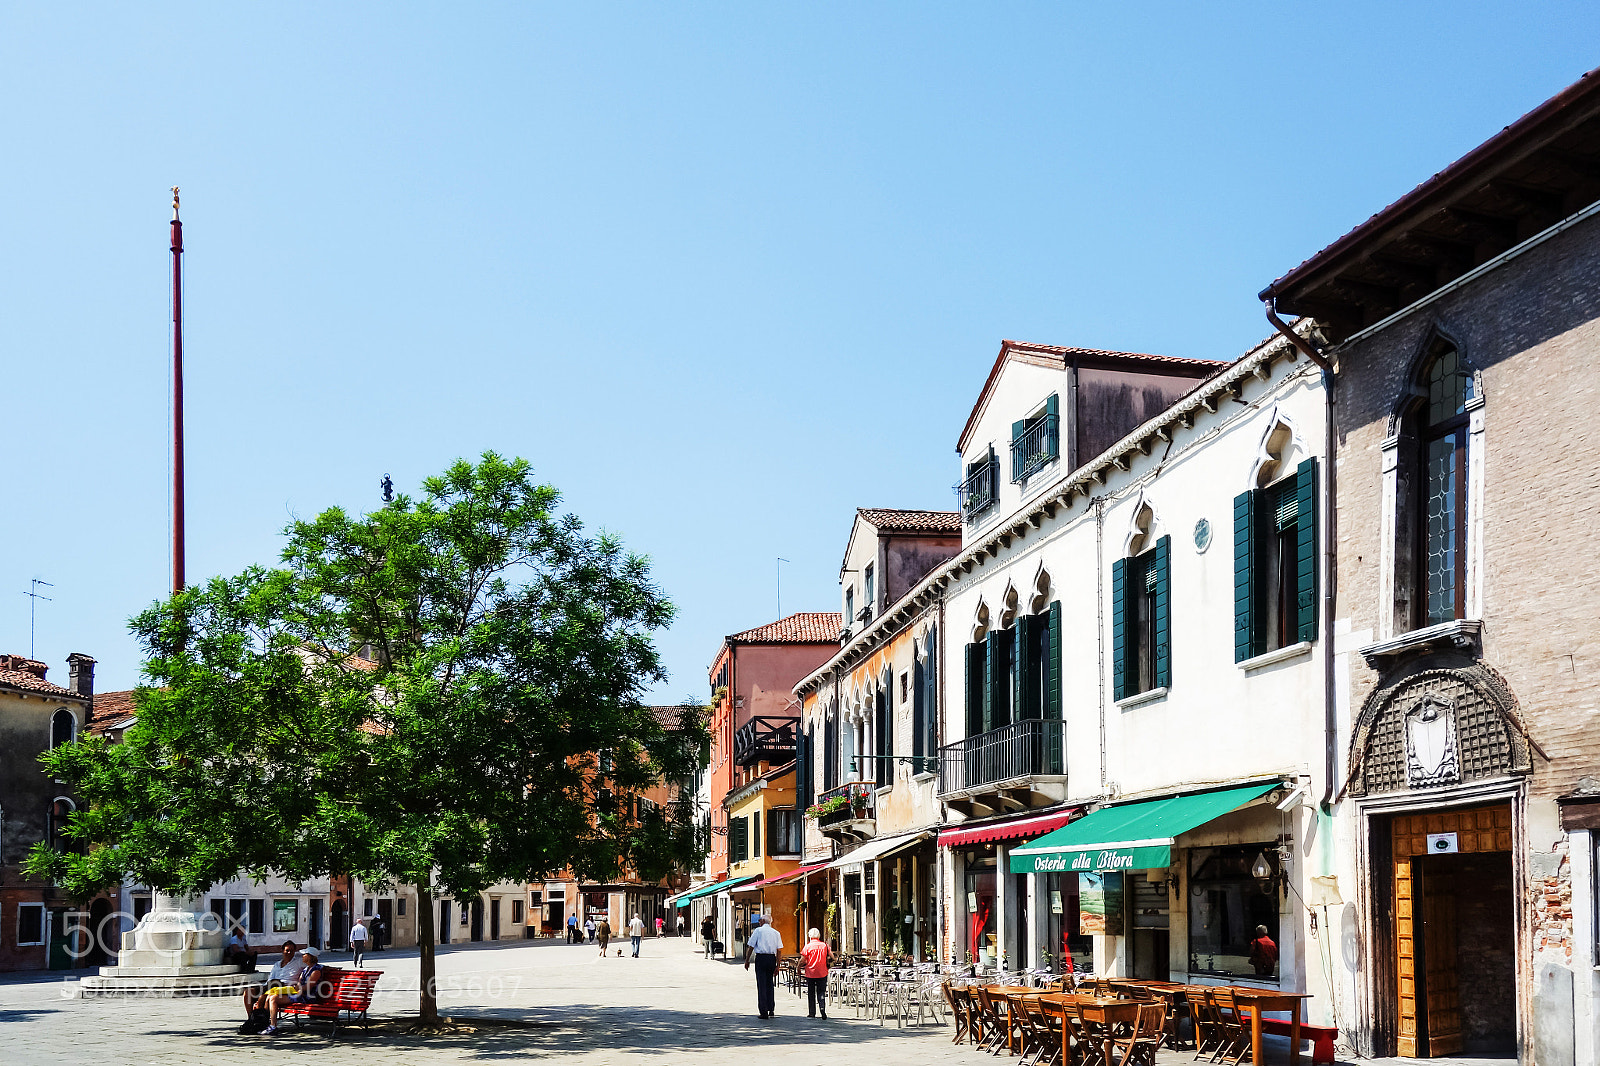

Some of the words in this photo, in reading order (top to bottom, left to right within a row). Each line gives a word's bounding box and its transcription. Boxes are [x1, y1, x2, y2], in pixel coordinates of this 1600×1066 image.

[1034, 856, 1067, 871] Osteria
[1071, 852, 1092, 869] alla
[1096, 850, 1133, 869] Bifora
